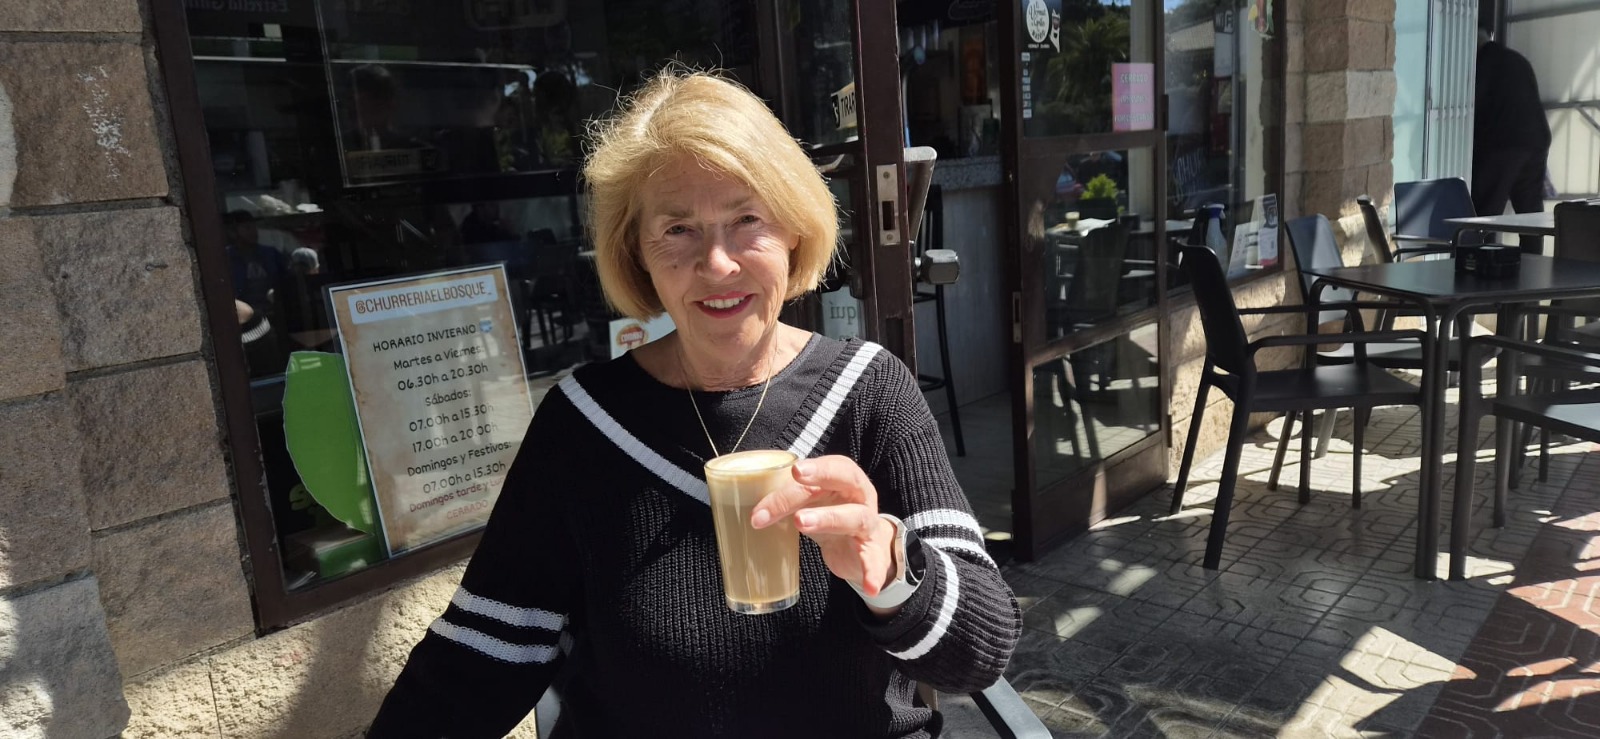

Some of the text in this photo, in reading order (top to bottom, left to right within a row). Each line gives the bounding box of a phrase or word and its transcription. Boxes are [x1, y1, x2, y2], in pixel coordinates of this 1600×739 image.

[355, 281, 493, 314] @CHURRERIAELBOSQUE_
[373, 324, 477, 353] HORARIO INVIERNO
[393, 354, 433, 370] Martes
[434, 352, 443, 362] a
[397, 362, 489, 391] 06.30h a 20.30h
[425, 389, 472, 407] Sábados:
[409, 402, 494, 432] 07.00h a 15.30h
[412, 421, 498, 453] 17.00h a 20.00h
[407, 440, 512, 477] Domingos y Festivos:
[423, 461, 507, 494] 07.00h a 15.30h
[409, 492, 455, 513] Domingos
[455, 482, 482, 497] tarde
[490, 476, 505, 487] Lun
[446, 499, 489, 520] CERRADO
